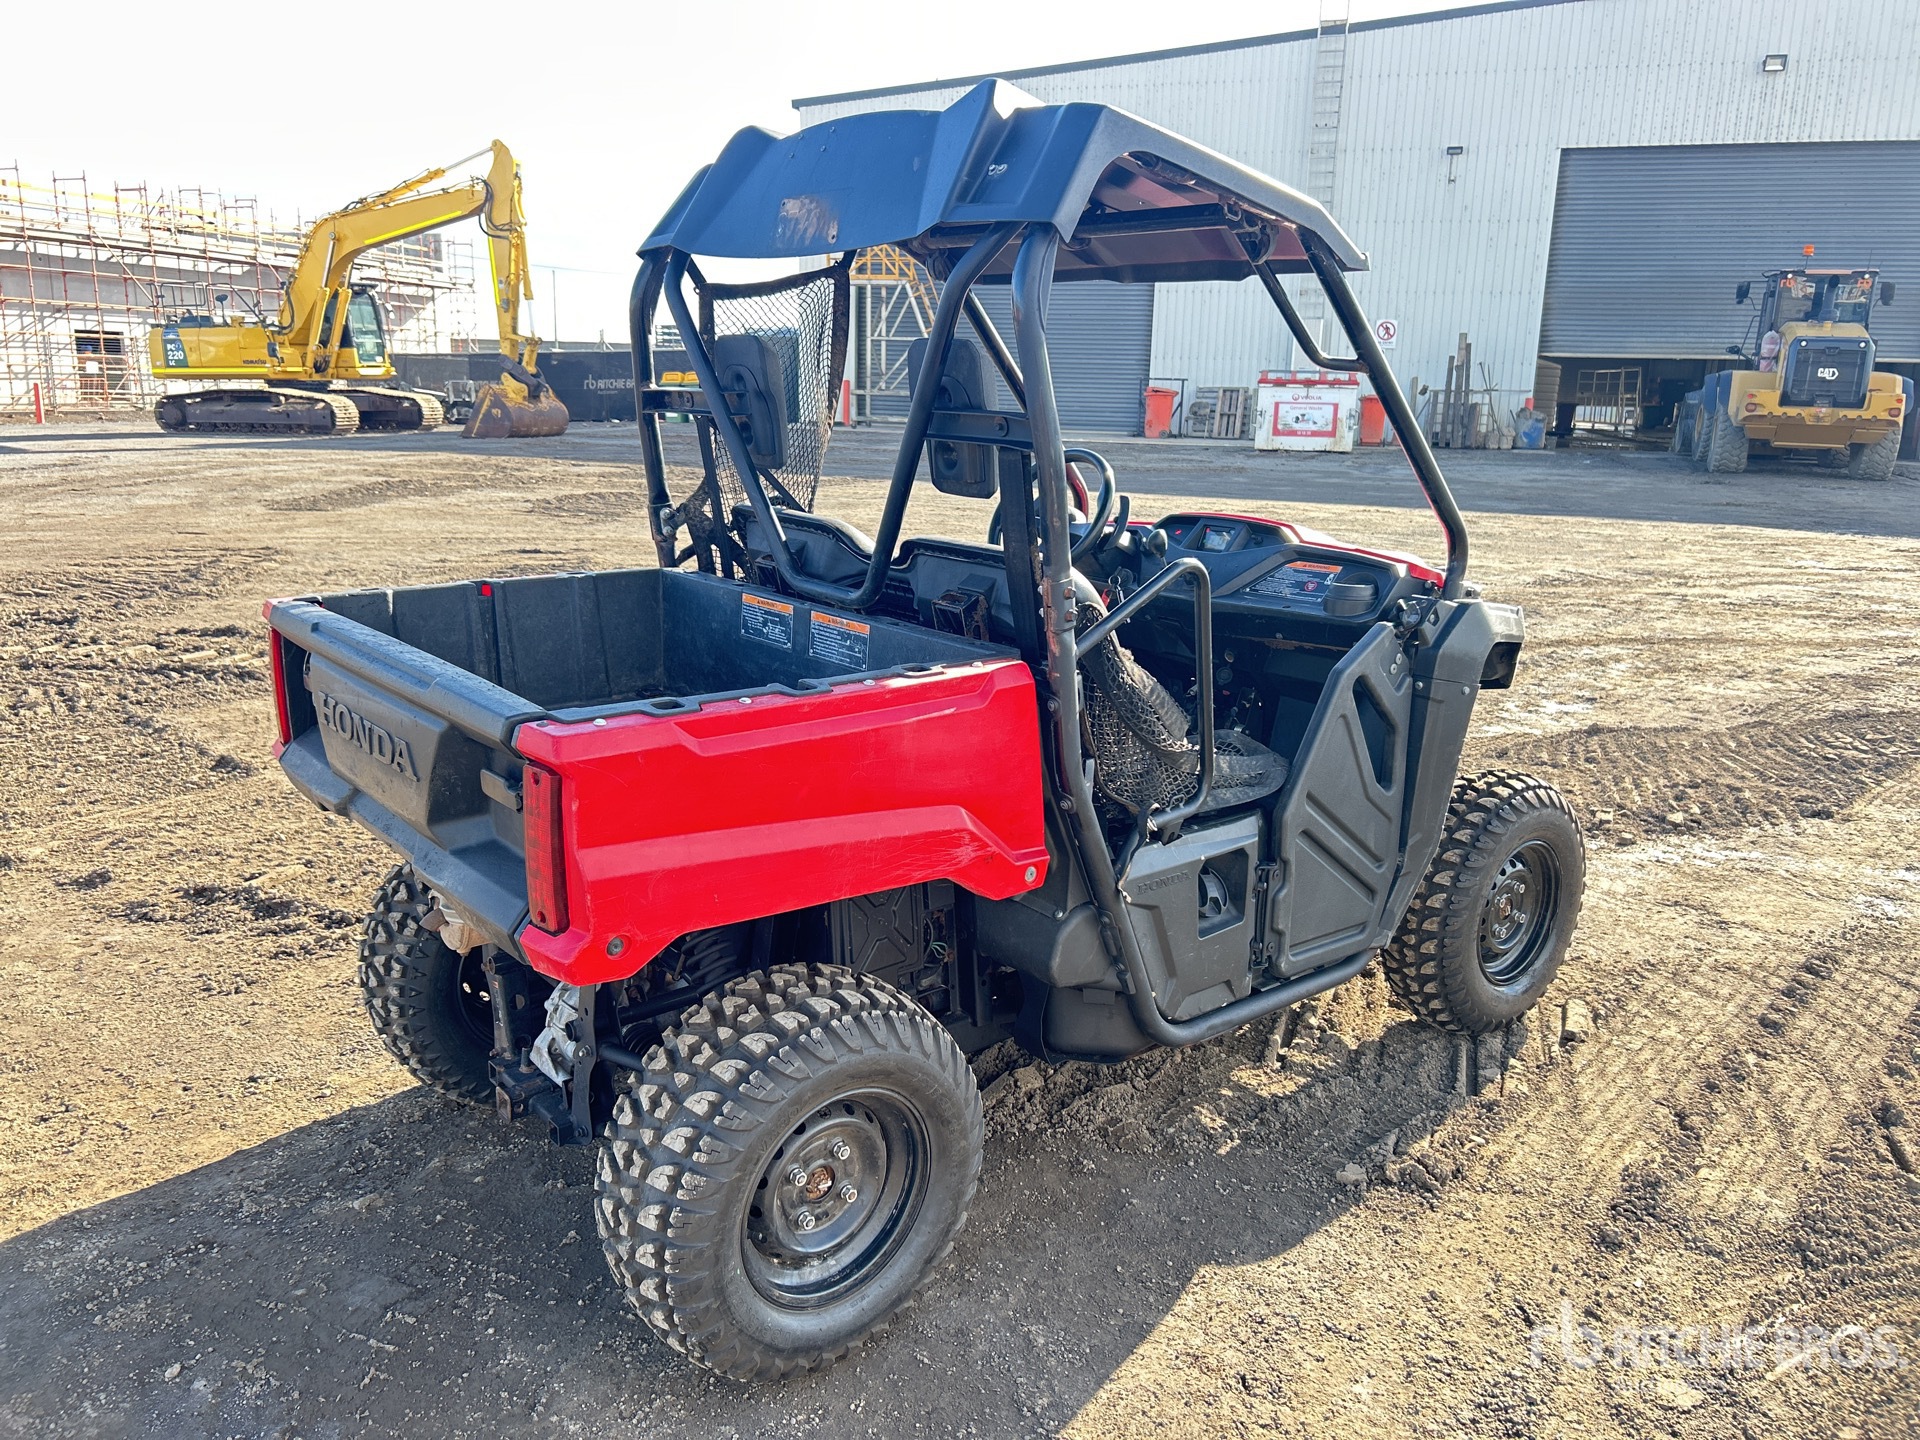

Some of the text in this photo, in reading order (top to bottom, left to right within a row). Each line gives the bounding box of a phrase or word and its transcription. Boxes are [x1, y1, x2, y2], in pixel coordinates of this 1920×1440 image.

[168, 350, 184, 360] 220
[1817, 367, 1835, 379] CAT
[597, 378, 626, 390] RITCHIE
[319, 691, 420, 782] HONDA
[1137, 869, 1192, 895] HONDA
